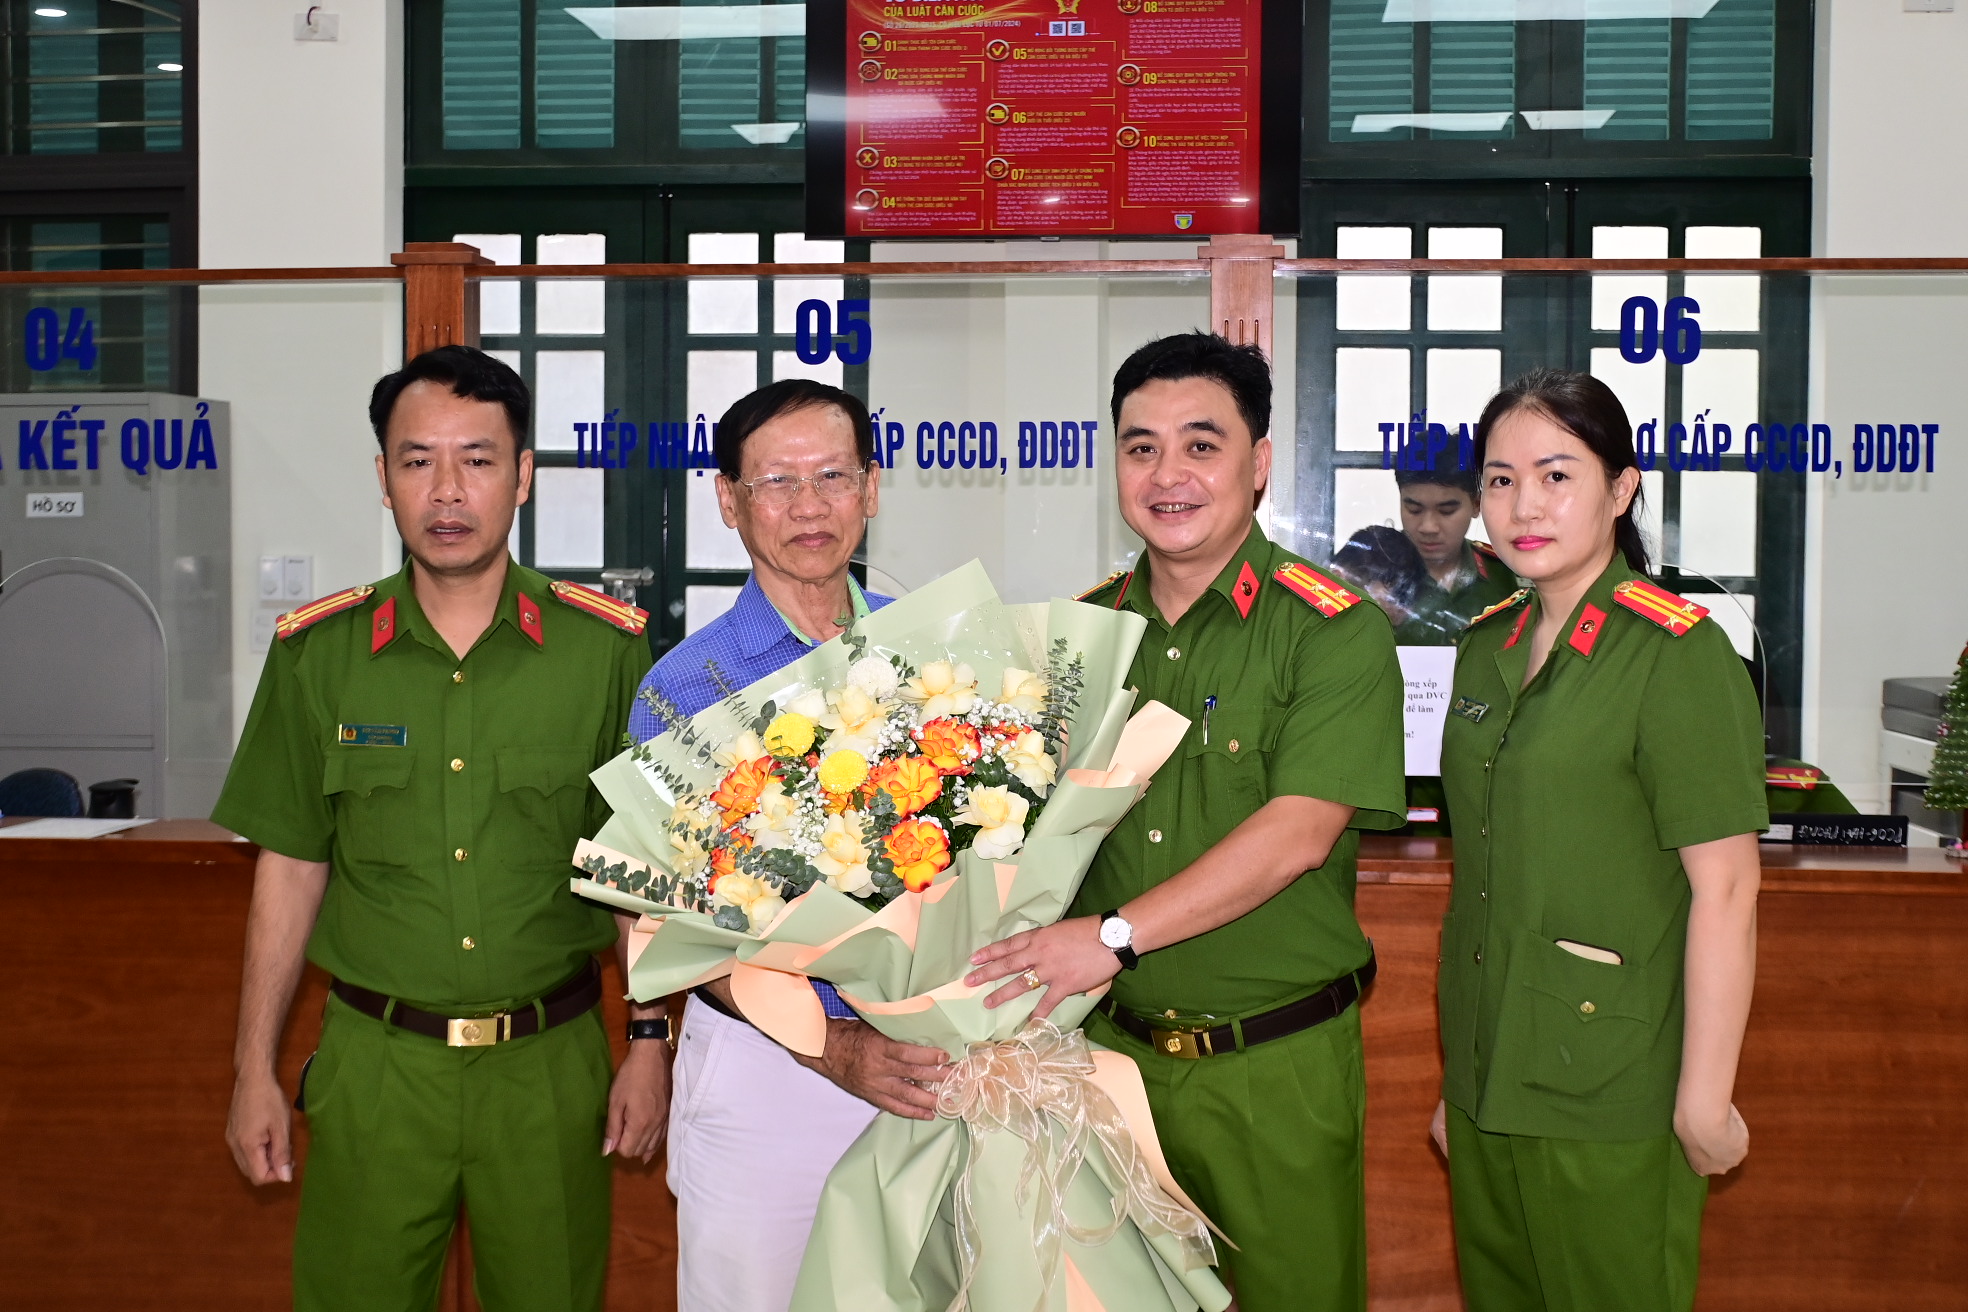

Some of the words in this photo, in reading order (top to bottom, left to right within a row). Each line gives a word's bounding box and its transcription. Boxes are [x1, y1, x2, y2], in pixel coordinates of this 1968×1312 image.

[884, 4, 904, 17] CỦA
[907, 5, 931, 18] LUẬT
[935, 5, 955, 16] CĂN
[958, 4, 984, 16] CƯỚC
[1143, 1, 1157, 13] 08
[884, 40, 897, 51] 01
[1013, 48, 1027, 60] 05
[884, 69, 898, 80] 02
[1142, 73, 1157, 84] 09
[1013, 112, 1027, 123] 06
[1143, 136, 1157, 147] 10
[884, 156, 898, 167] 03
[1011, 169, 1025, 180] 07
[882, 197, 896, 208] 04
[795, 299, 872, 365] 05
[1619, 296, 1701, 365] 06
[25, 307, 97, 371] 04
[19, 405, 105, 470] KẾT
[121, 402, 217, 475] QUẢ
[573, 409, 638, 469] TIẾP
[649, 413, 720, 477] NHẬ
[871, 408, 905, 469] ẤP
[916, 421, 1007, 475] CCCD,
[1018, 421, 1098, 468] ĐDĐT
[1378, 408, 1448, 471] TIẾP
[1668, 408, 1732, 472] CẤP
[1744, 423, 1842, 479] CCCD,
[1853, 424, 1939, 473] ĐDĐT
[1404, 680, 1420, 689] òng
[1422, 678, 1437, 690] xếp
[1407, 692, 1423, 700] qua
[1426, 691, 1447, 700] DVC
[1406, 703, 1416, 713] để
[1418, 705, 1434, 713] làm
